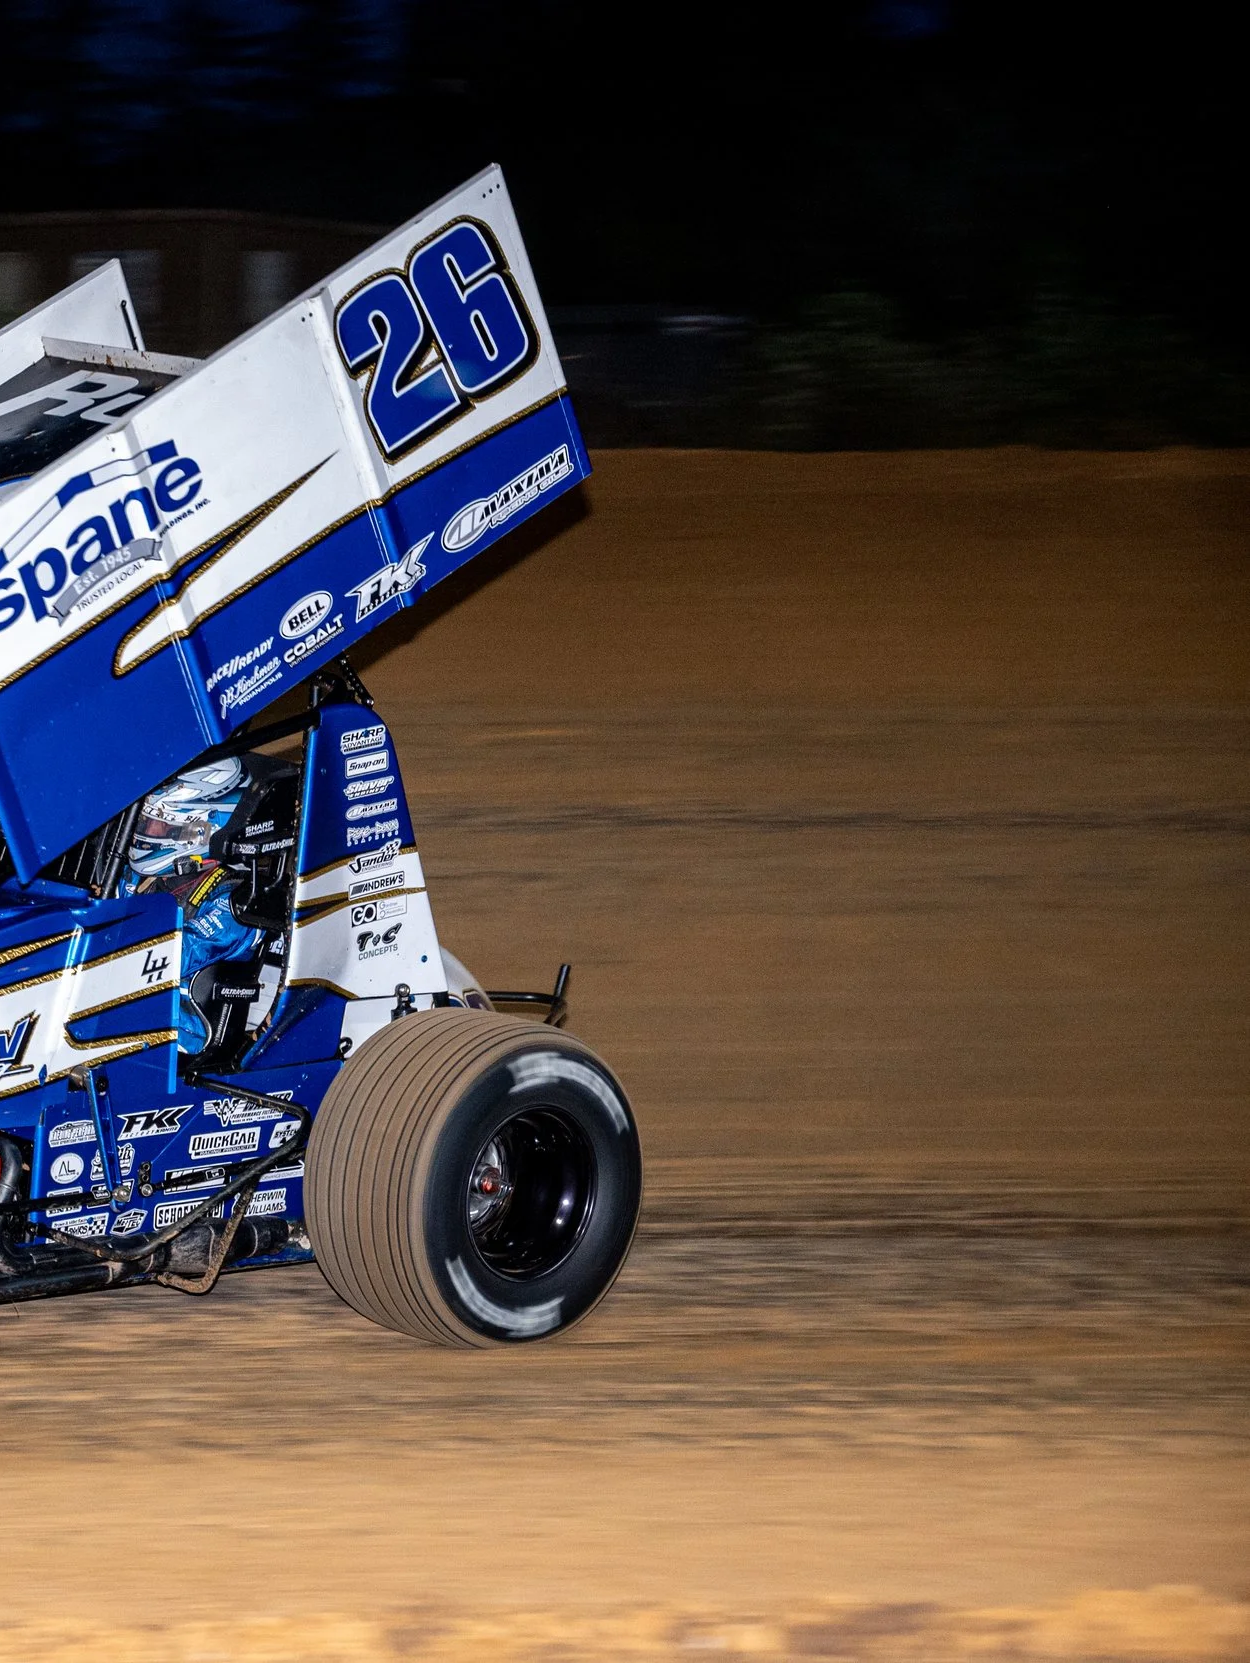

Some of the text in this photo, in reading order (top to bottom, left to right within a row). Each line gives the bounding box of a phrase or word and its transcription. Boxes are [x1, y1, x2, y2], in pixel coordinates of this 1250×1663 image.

[334, 217, 540, 463] 26
[72, 547, 132, 595] Est. 1945
[76, 561, 145, 612] TRUSTED LOCAL
[288, 599, 326, 632] BELL
[283, 613, 344, 664] COBALT
[238, 671, 283, 706] INDIANAPOLIS
[358, 943, 399, 961] CONCEPTS
[250, 1190, 285, 1203] HERWIN
